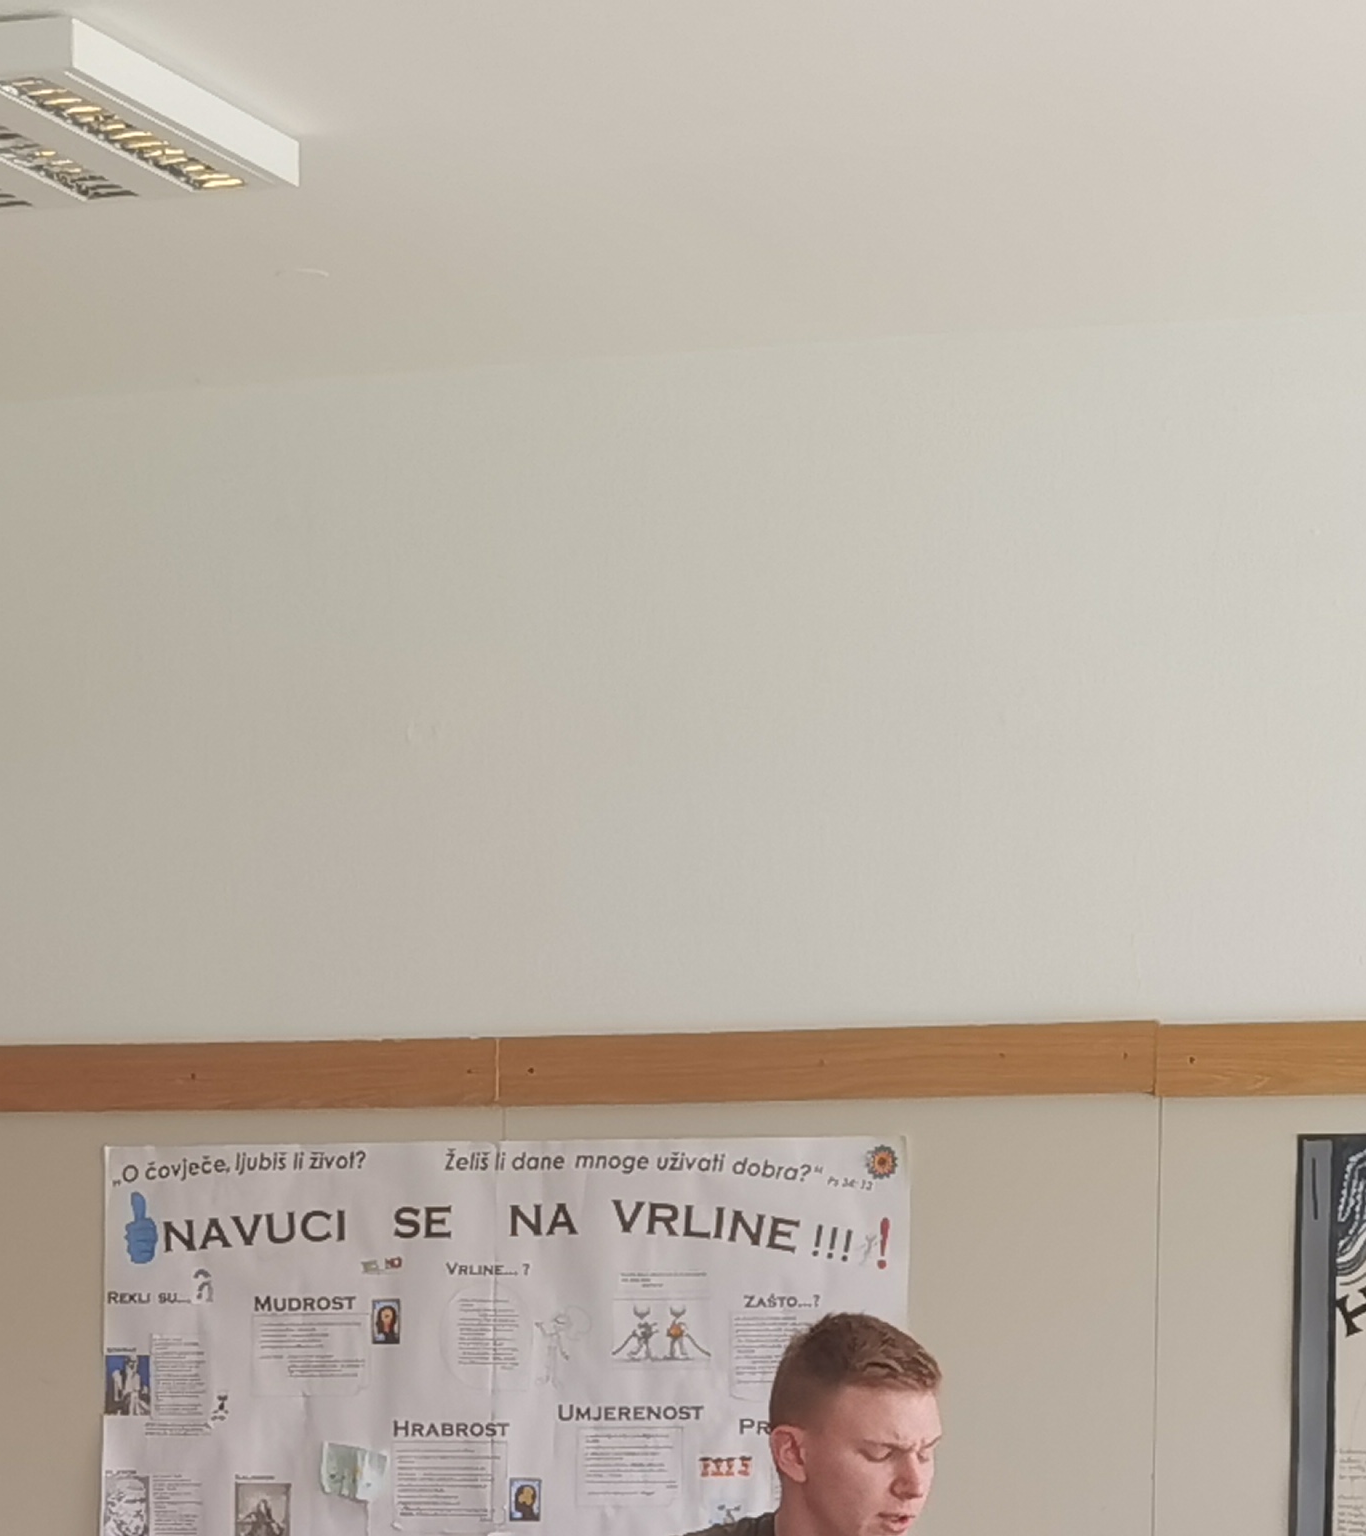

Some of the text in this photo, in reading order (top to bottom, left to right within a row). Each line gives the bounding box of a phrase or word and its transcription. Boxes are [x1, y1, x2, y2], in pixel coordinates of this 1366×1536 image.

[145, 1154, 231, 1183] čovječe,
[235, 1149, 287, 1173] ljubiš
[292, 1149, 304, 1171] li
[309, 1148, 367, 1171] život?
[444, 1147, 490, 1171] Želiš
[494, 1151, 505, 1171] li
[512, 1151, 565, 1172] dane
[574, 1153, 649, 1176] mnoge
[656, 1151, 725, 1173] uživati
[162, 1208, 347, 1254] NAVUCI
[393, 1204, 453, 1240] SE
[509, 1202, 579, 1239] NA
[612, 1199, 802, 1255] VRLINE
[253, 1295, 357, 1312] MUDROST
[557, 1404, 705, 1422] UMJERENOST
[392, 1419, 511, 1438] HRABROST
